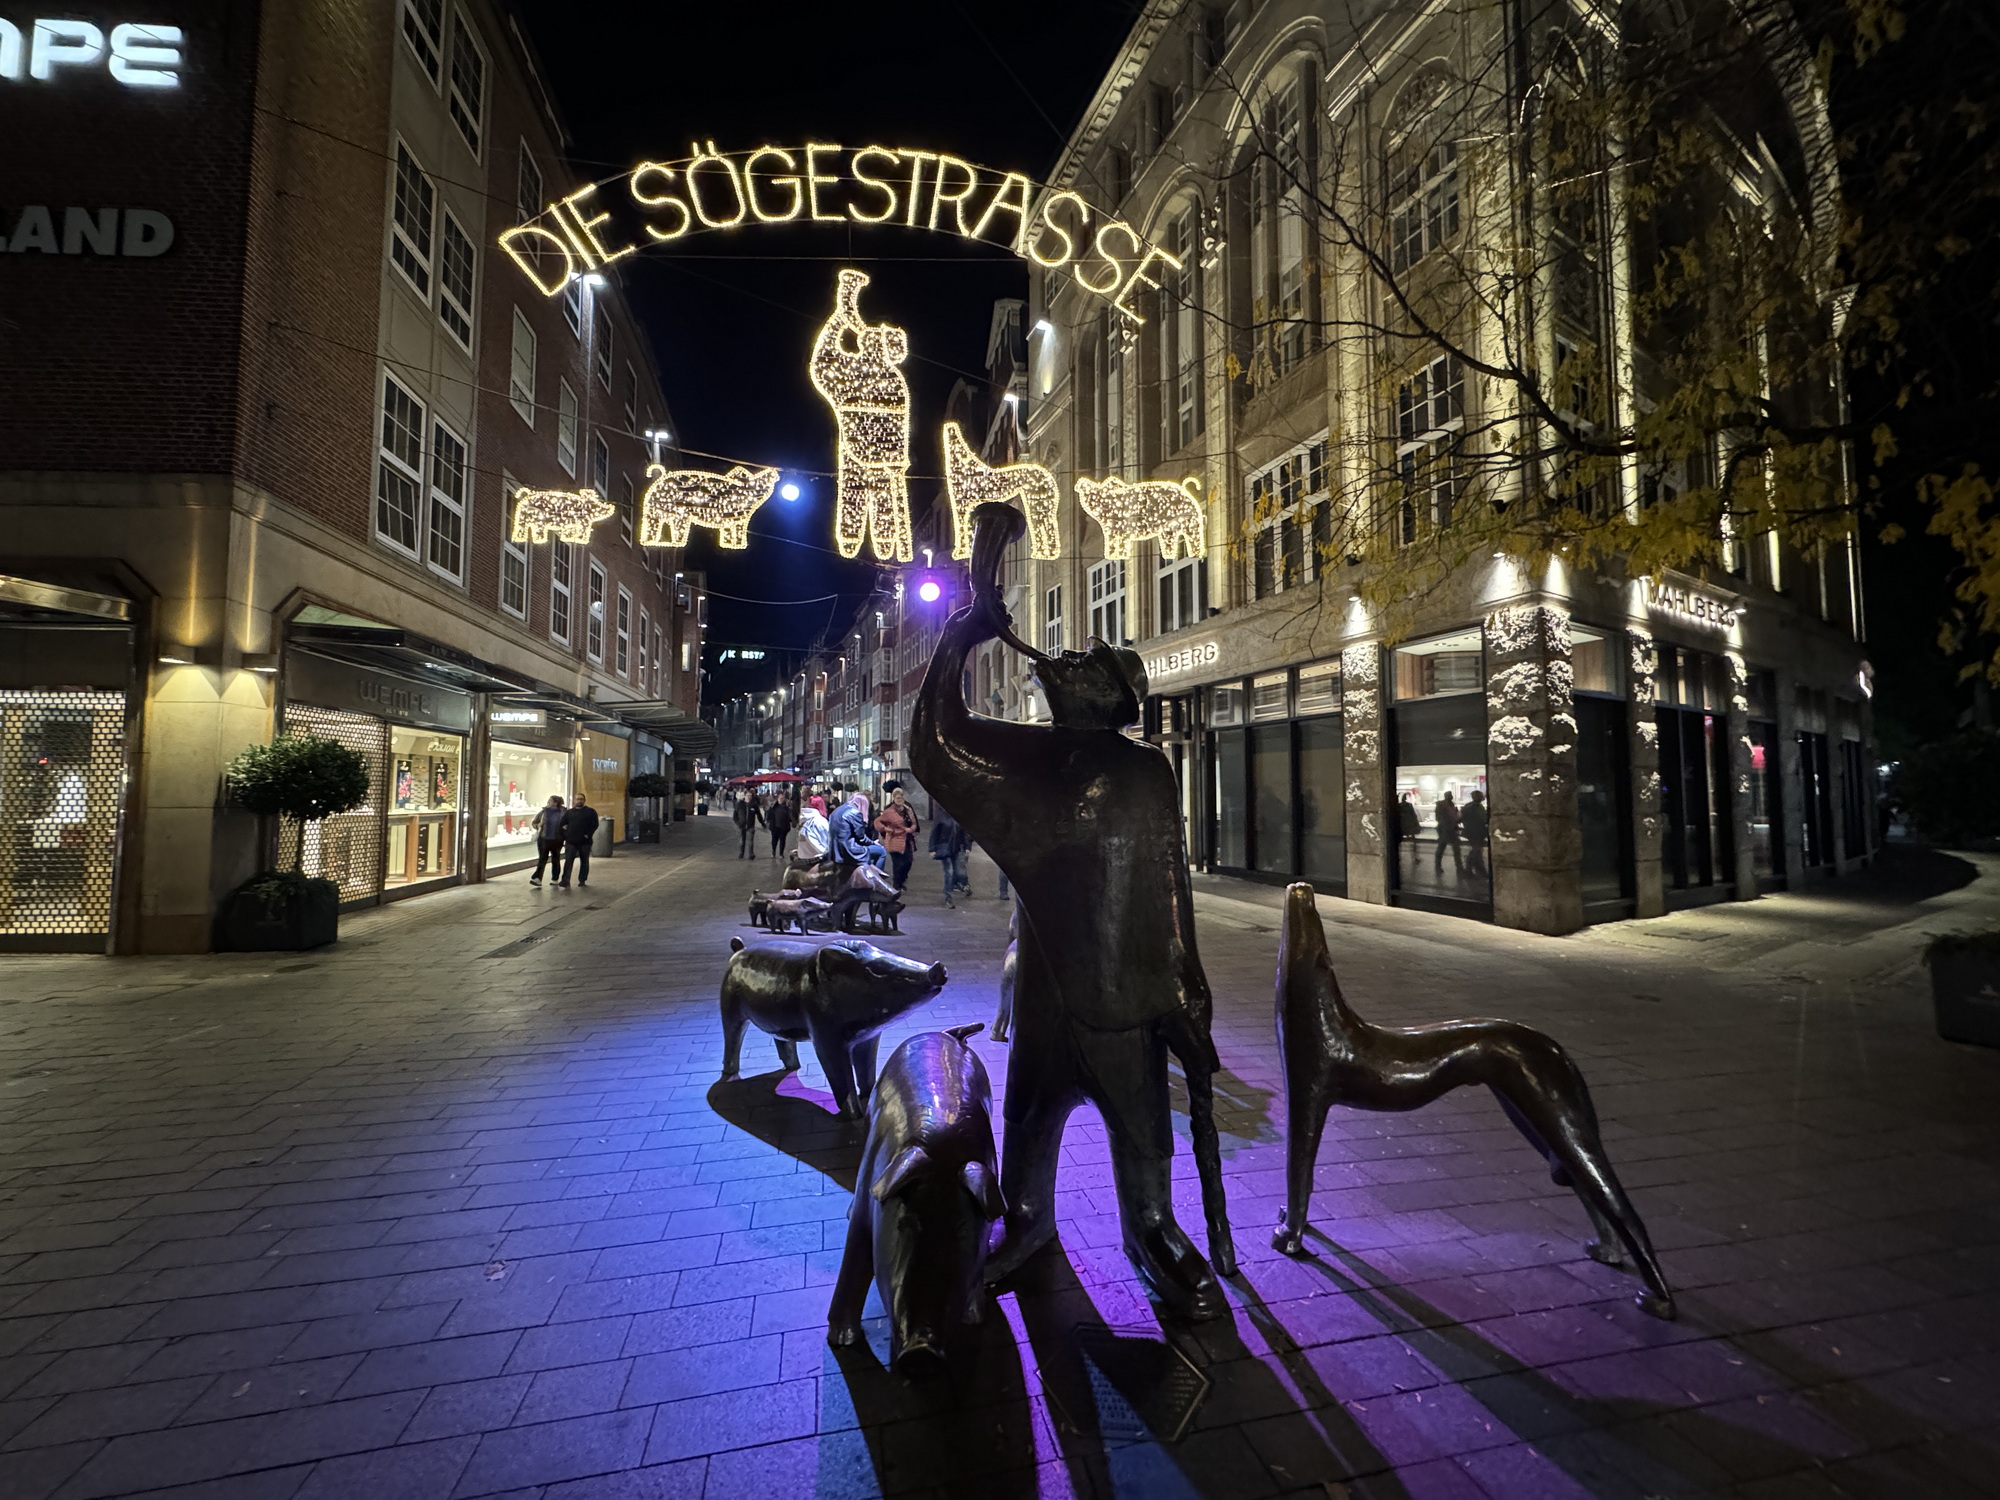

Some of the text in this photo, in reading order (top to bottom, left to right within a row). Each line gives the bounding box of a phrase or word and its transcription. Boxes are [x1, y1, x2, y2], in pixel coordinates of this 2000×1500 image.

[0, 204, 175, 257] AND
[498, 140, 1182, 325] DIE SÖGESTRASSE
[1146, 642, 1219, 679] HLBERG
